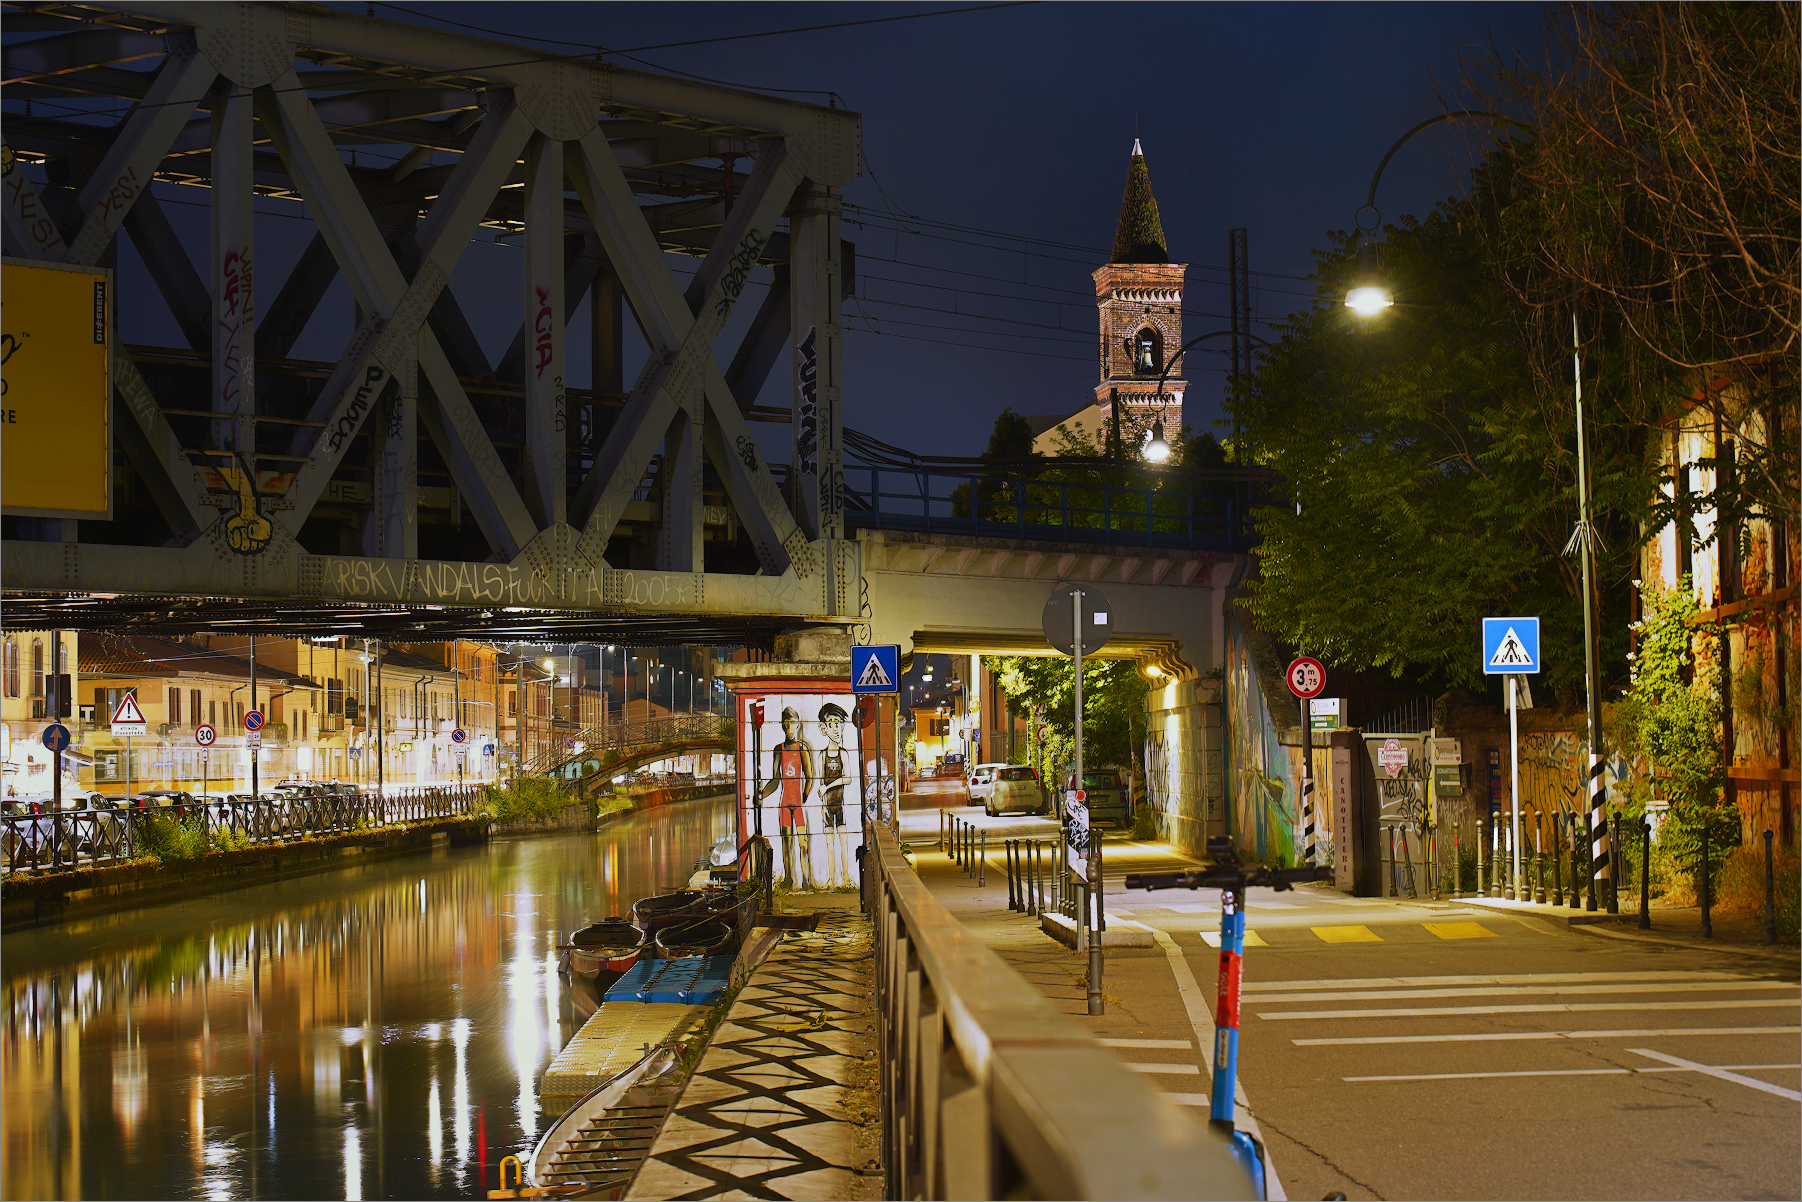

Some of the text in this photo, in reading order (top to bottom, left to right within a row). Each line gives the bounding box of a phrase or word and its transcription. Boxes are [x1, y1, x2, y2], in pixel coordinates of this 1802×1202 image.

[6, 177, 60, 252] YES!
[99, 166, 140, 222] YES!
[1296, 669, 1305, 686] 3
[199, 730, 212, 741] 30
[1340, 777, 1348, 873] CANOTTIERI
